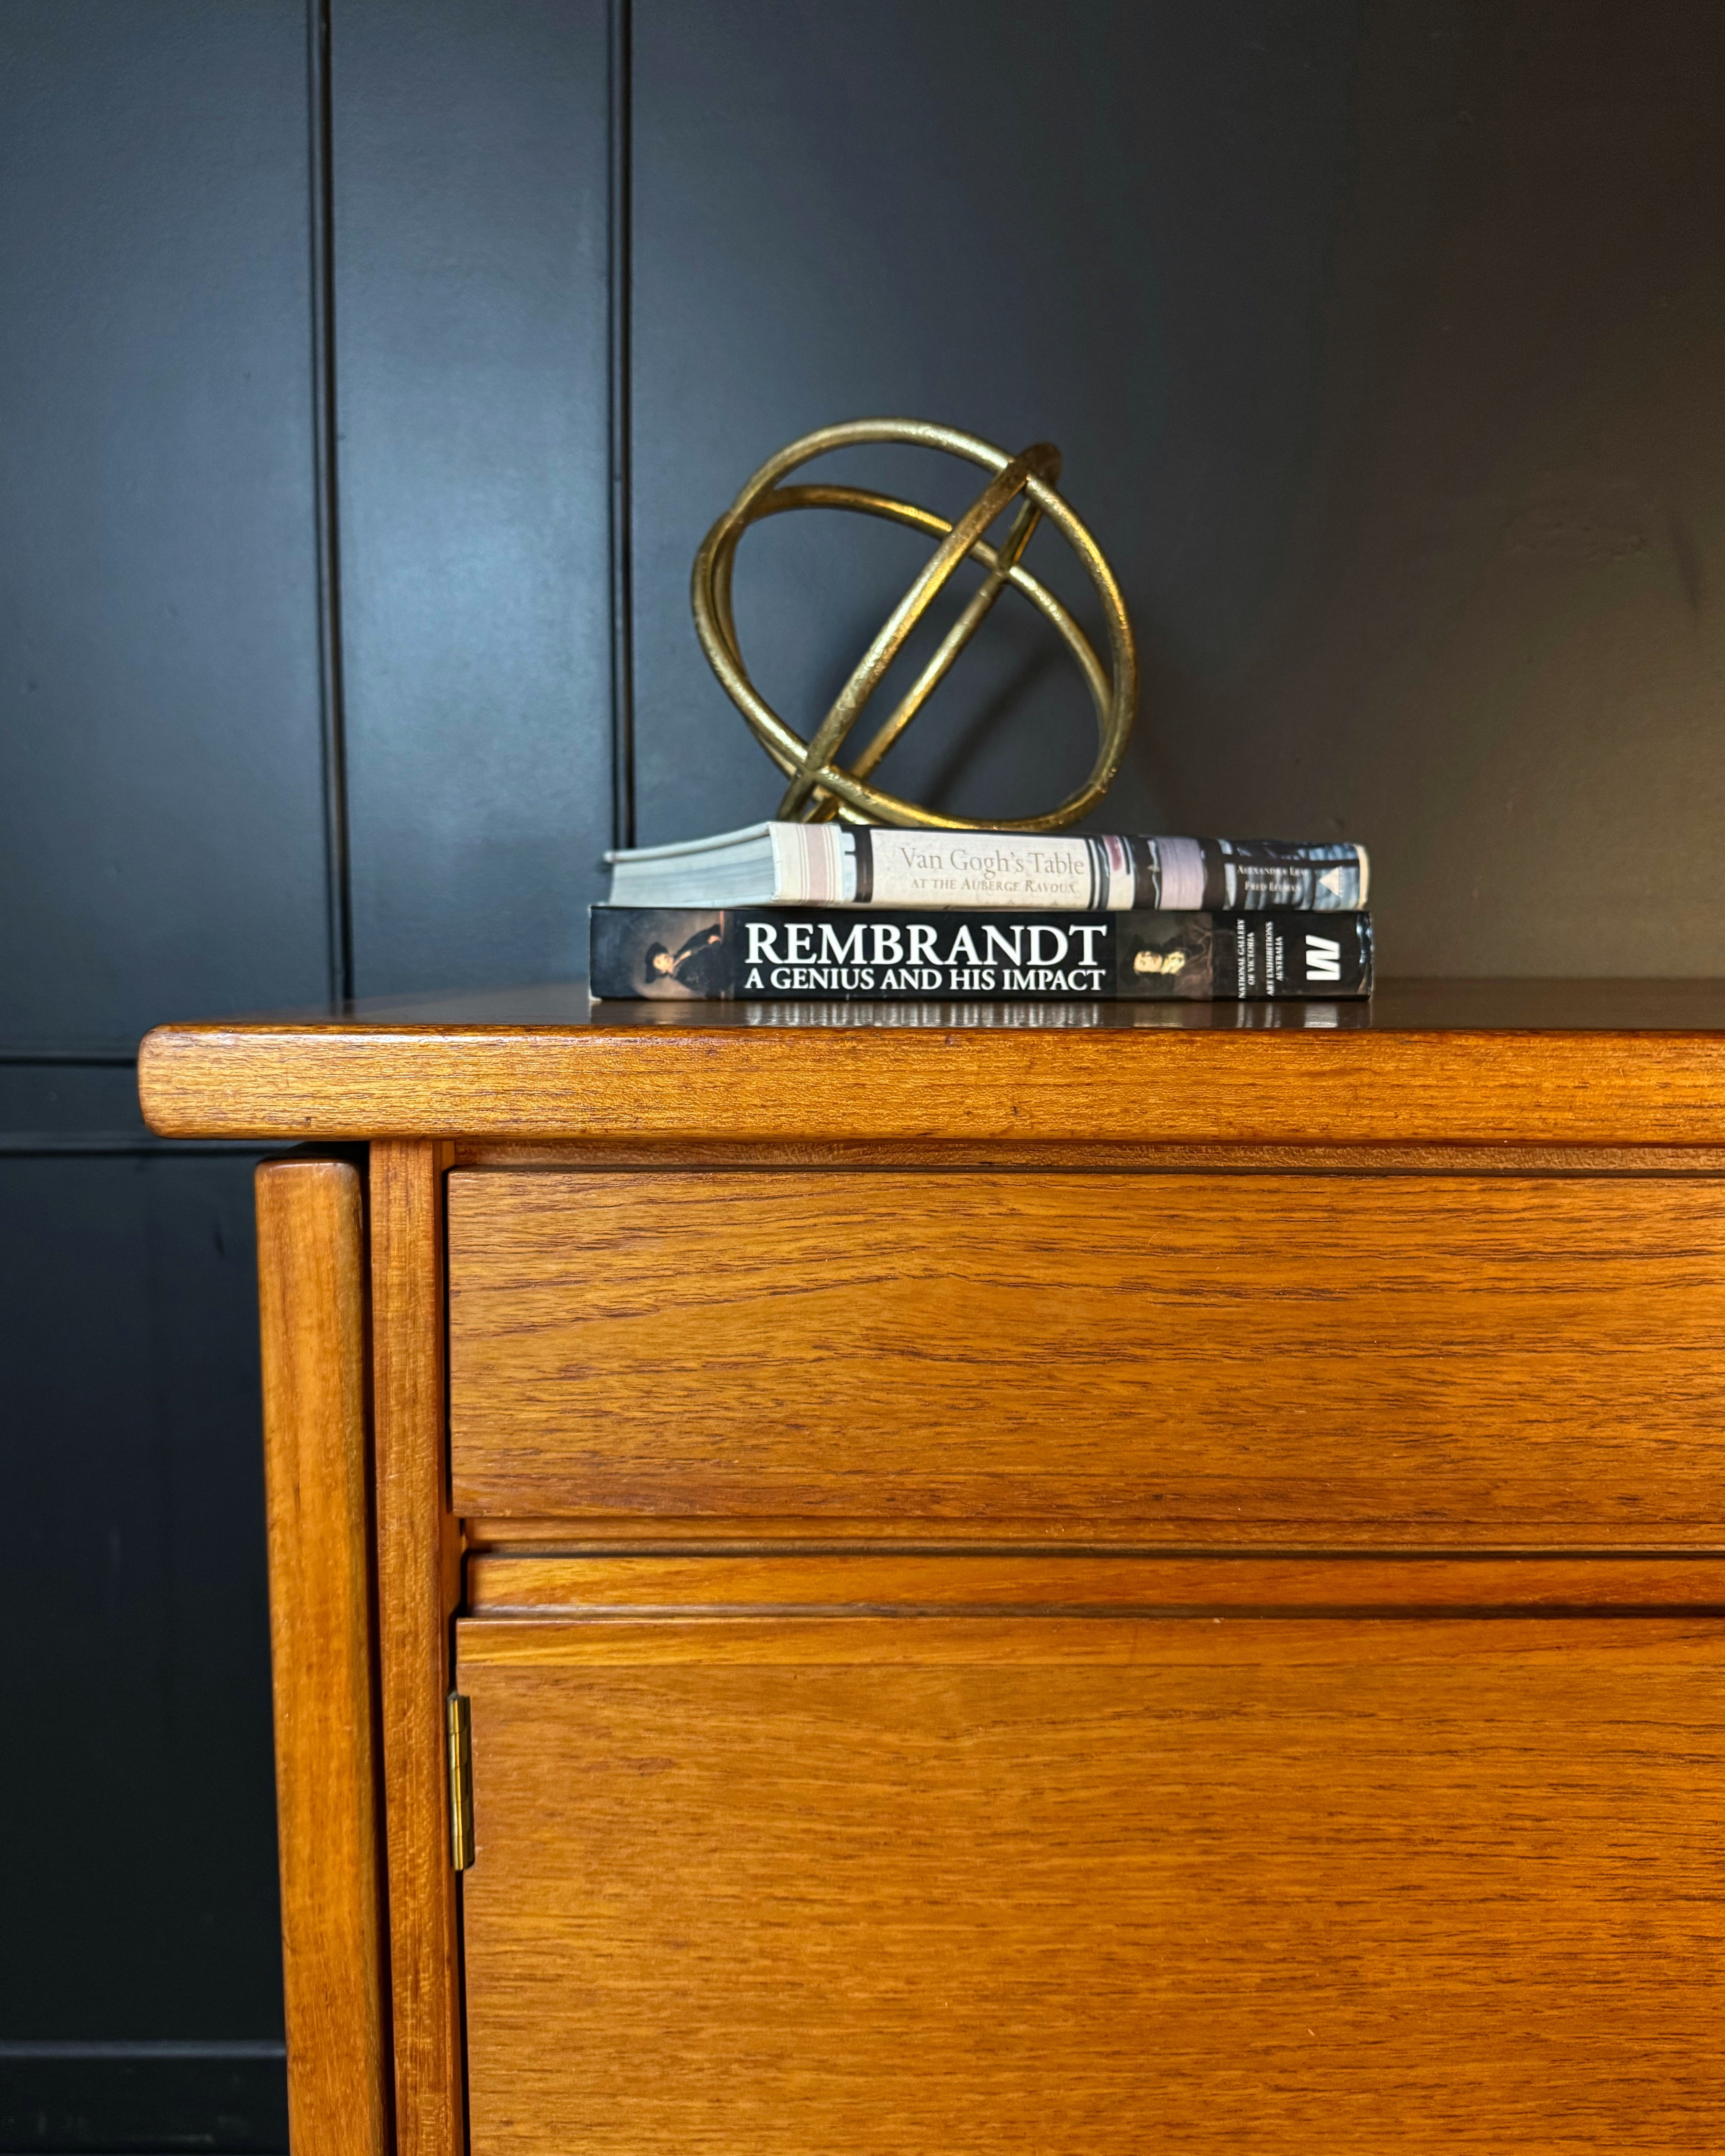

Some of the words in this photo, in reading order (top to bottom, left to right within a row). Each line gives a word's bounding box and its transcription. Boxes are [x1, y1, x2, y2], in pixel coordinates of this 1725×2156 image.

[900, 848, 943, 870] Van
[950, 849, 1025, 880] Gogh's
[1028, 850, 1085, 875] Table
[911, 879, 928, 889] AT
[932, 879, 956, 890] THE
[961, 878, 1020, 892] AUBERGE
[1025, 880, 1076, 894] RAVOUX
[744, 923, 1107, 967] REMBRANDT
[1237, 918, 1246, 956] GALLERY
[1246, 932, 1255, 972] VICTORIA
[1265, 921, 1274, 979] EXHIBITIONS
[1275, 935, 1284, 981] AUSTRALIA
[744, 967, 765, 990] A
[771, 968, 875, 990] GENIUS
[879, 968, 942, 990] AND
[949, 969, 996, 990] HIS
[1002, 969, 1105, 991] IMPACT
[1237, 957, 1246, 999] NATIONAL
[1247, 973, 1255, 986] OF
[1266, 979, 1275, 997] ART
